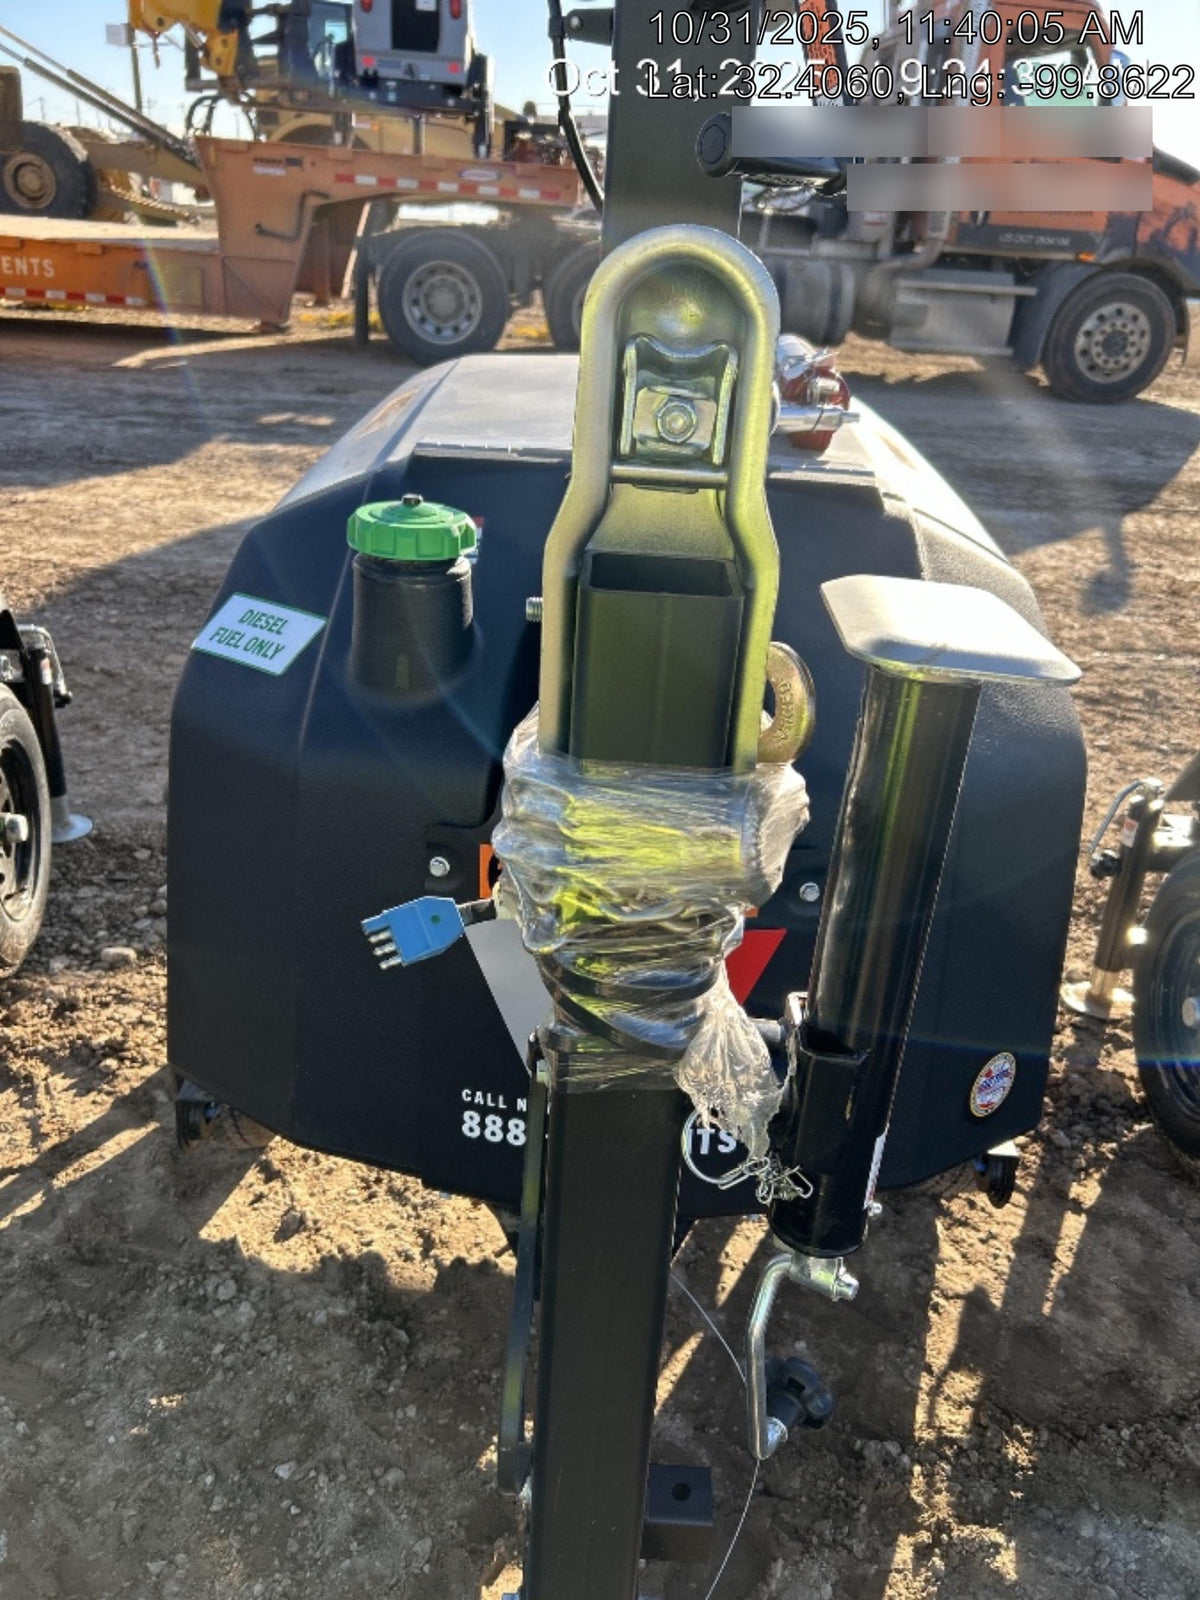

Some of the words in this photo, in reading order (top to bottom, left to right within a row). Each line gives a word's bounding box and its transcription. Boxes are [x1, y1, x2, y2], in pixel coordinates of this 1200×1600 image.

[1, 255, 56, 278] ENTS
[238, 608, 289, 636] DIESEL
[208, 626, 247, 650] FUEL
[243, 636, 285, 660] ONLY
[461, 1088, 508, 1109] CALL
[461, 1109, 527, 1146] 888
